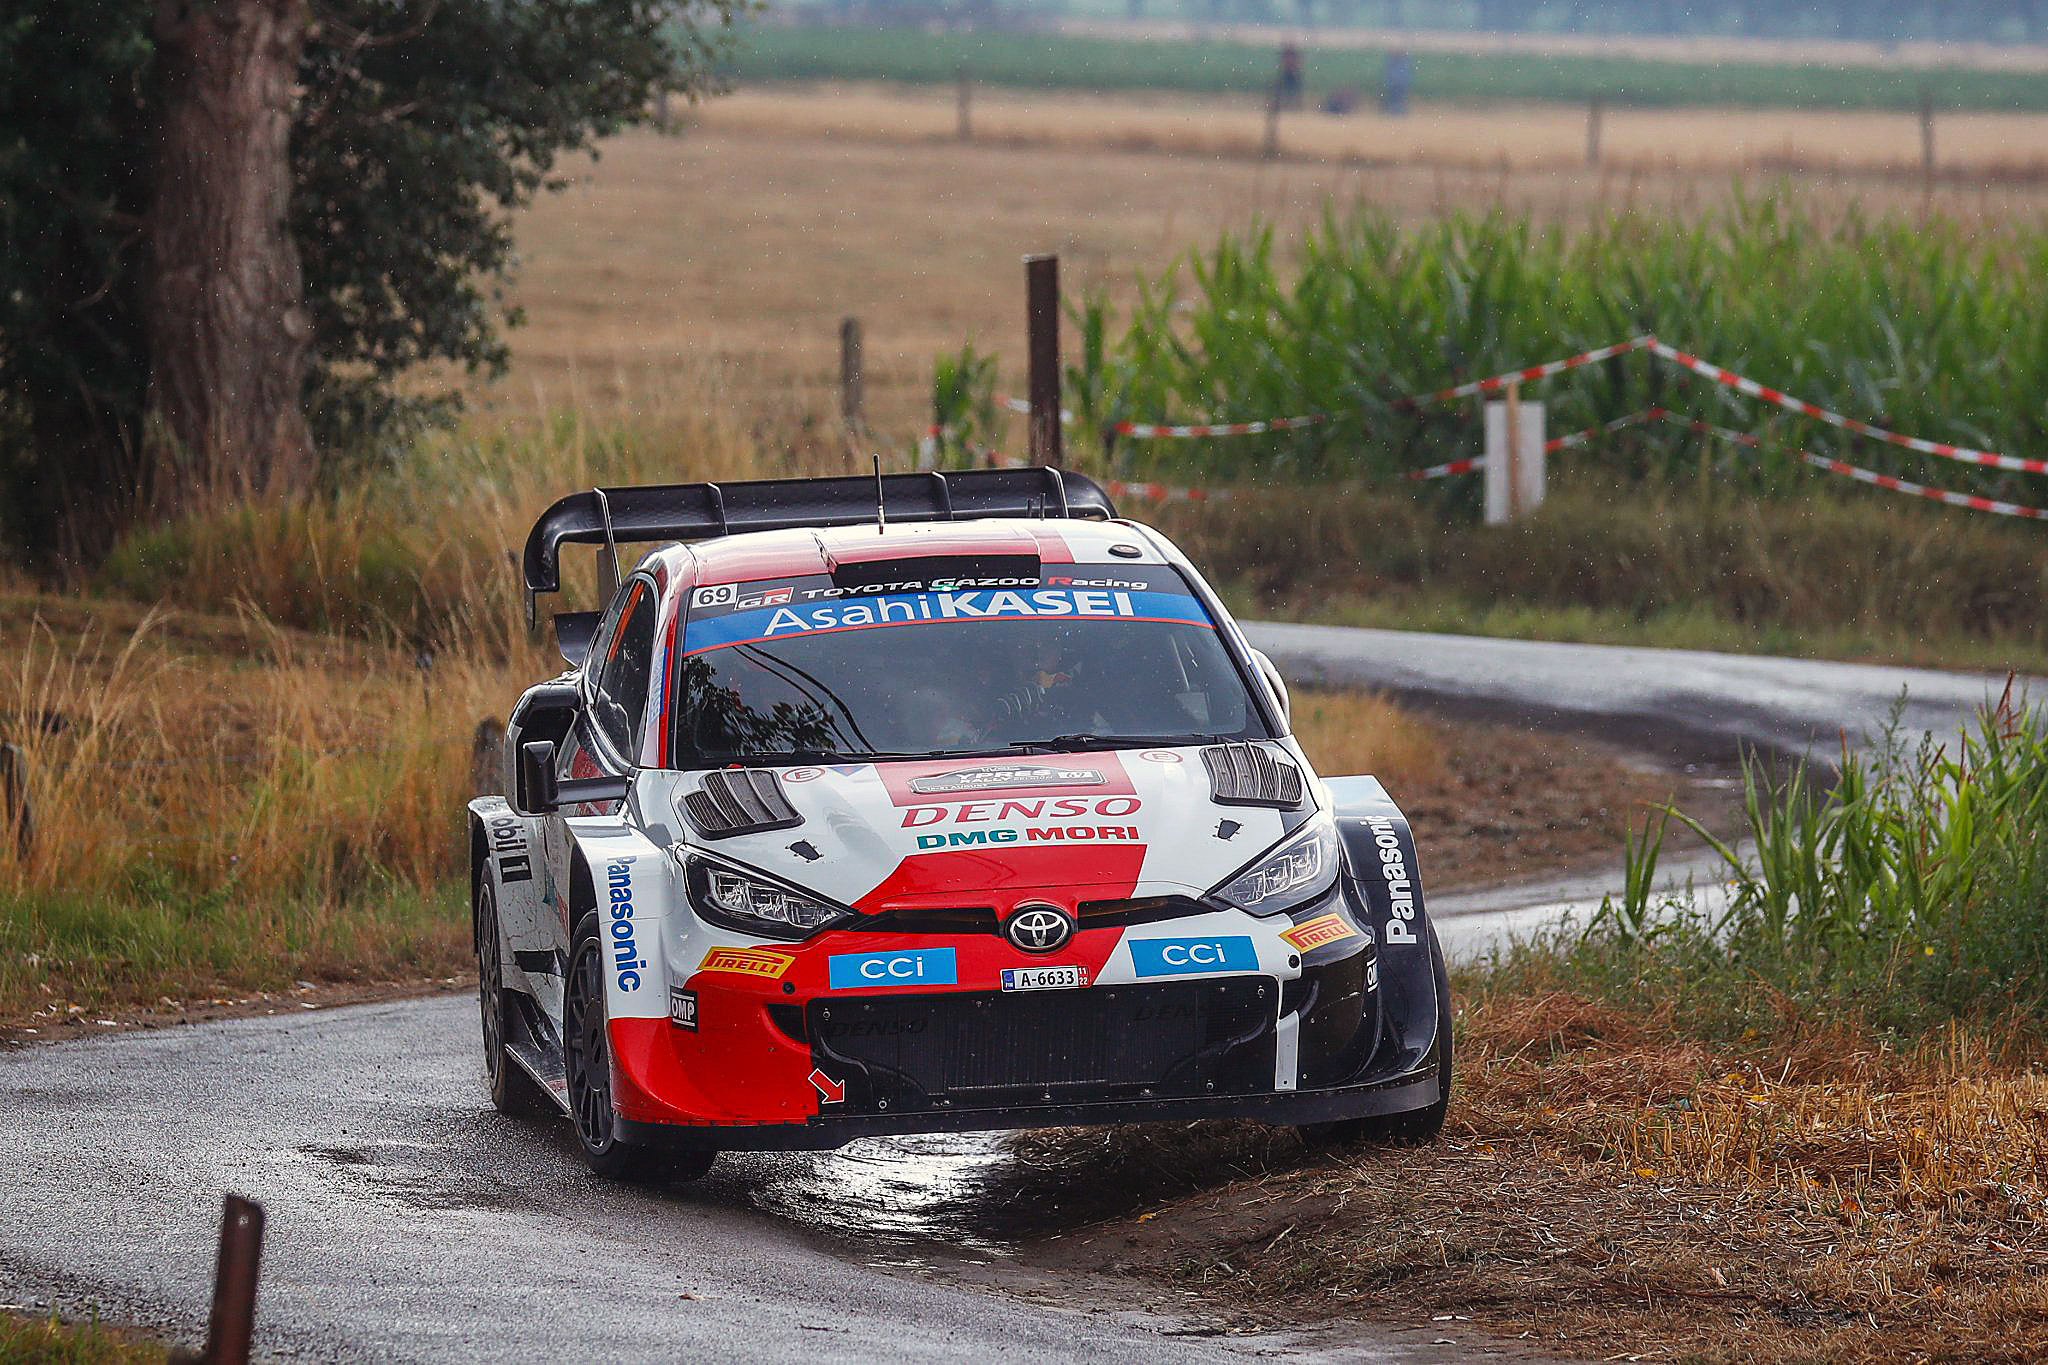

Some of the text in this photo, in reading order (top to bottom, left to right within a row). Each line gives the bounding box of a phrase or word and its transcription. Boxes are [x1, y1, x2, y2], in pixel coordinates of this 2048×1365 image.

[699, 586, 731, 606] 69
[801, 576, 1148, 599] TOYOTA GAZOO Racing
[955, 769, 1053, 781] YPRES
[900, 797, 1142, 829] DENSO
[491, 816, 528, 851] obil
[916, 826, 1140, 850] DMG MORI
[1359, 814, 1418, 945] Panasonic
[606, 855, 647, 993] Panasonic
[1287, 917, 1350, 949] PIRELLI
[704, 950, 786, 974] PIRELLI
[1021, 970, 1075, 987] A-6633
[1078, 967, 1087, 975] 11
[1079, 977, 1088, 985] 22
[671, 998, 695, 1020] OMP
